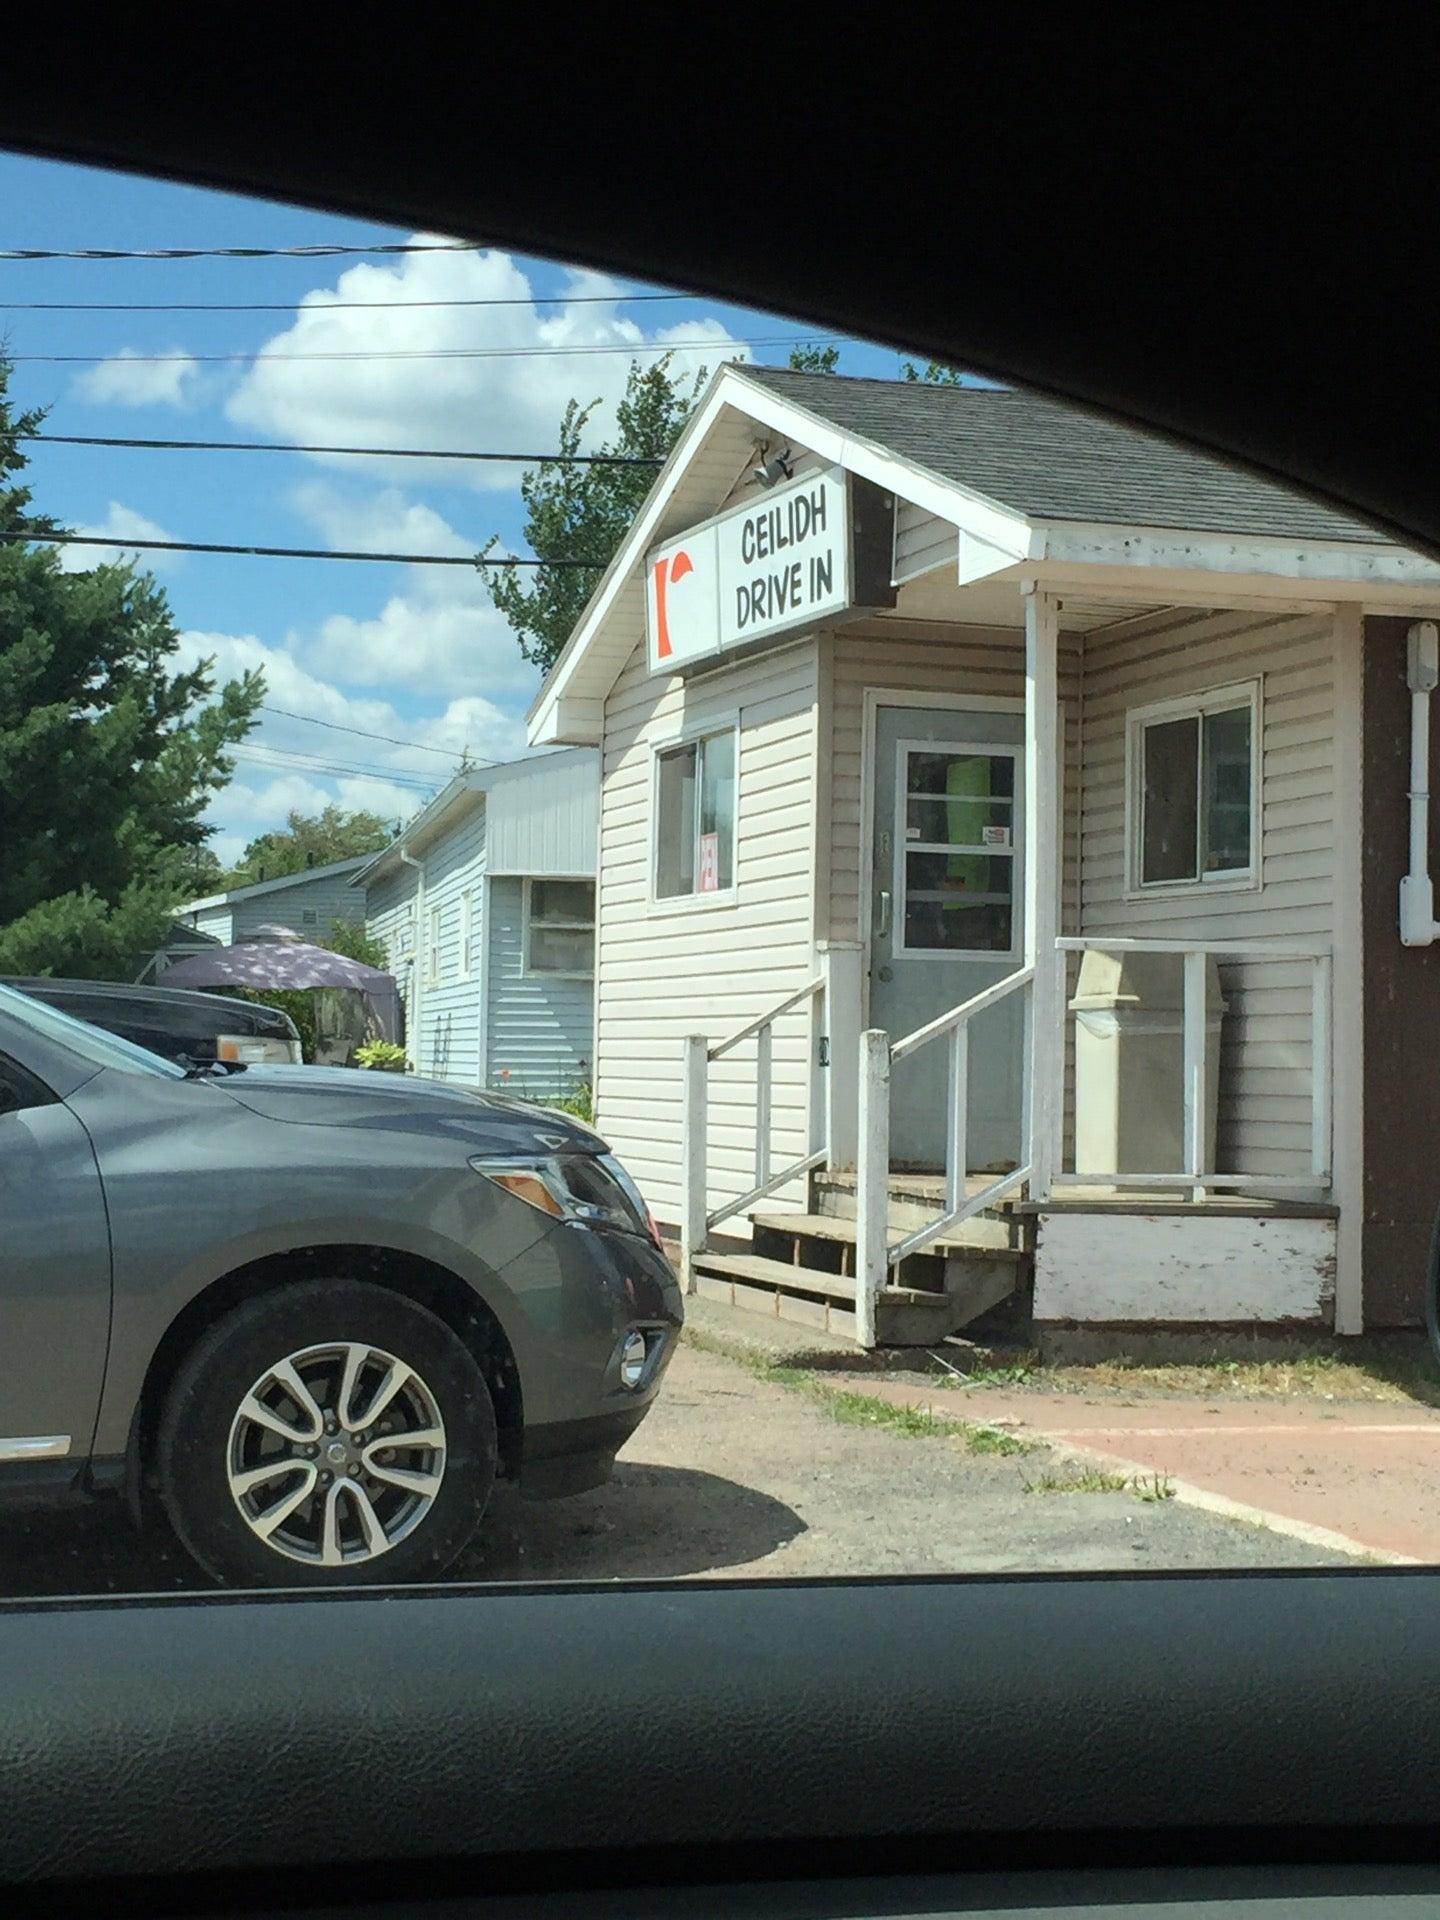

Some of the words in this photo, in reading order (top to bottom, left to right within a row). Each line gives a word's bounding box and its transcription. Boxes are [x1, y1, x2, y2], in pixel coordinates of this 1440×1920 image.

[742, 484, 826, 564] CEILIDH
[736, 562, 802, 629] DRIVE
[809, 549, 833, 603] IN
